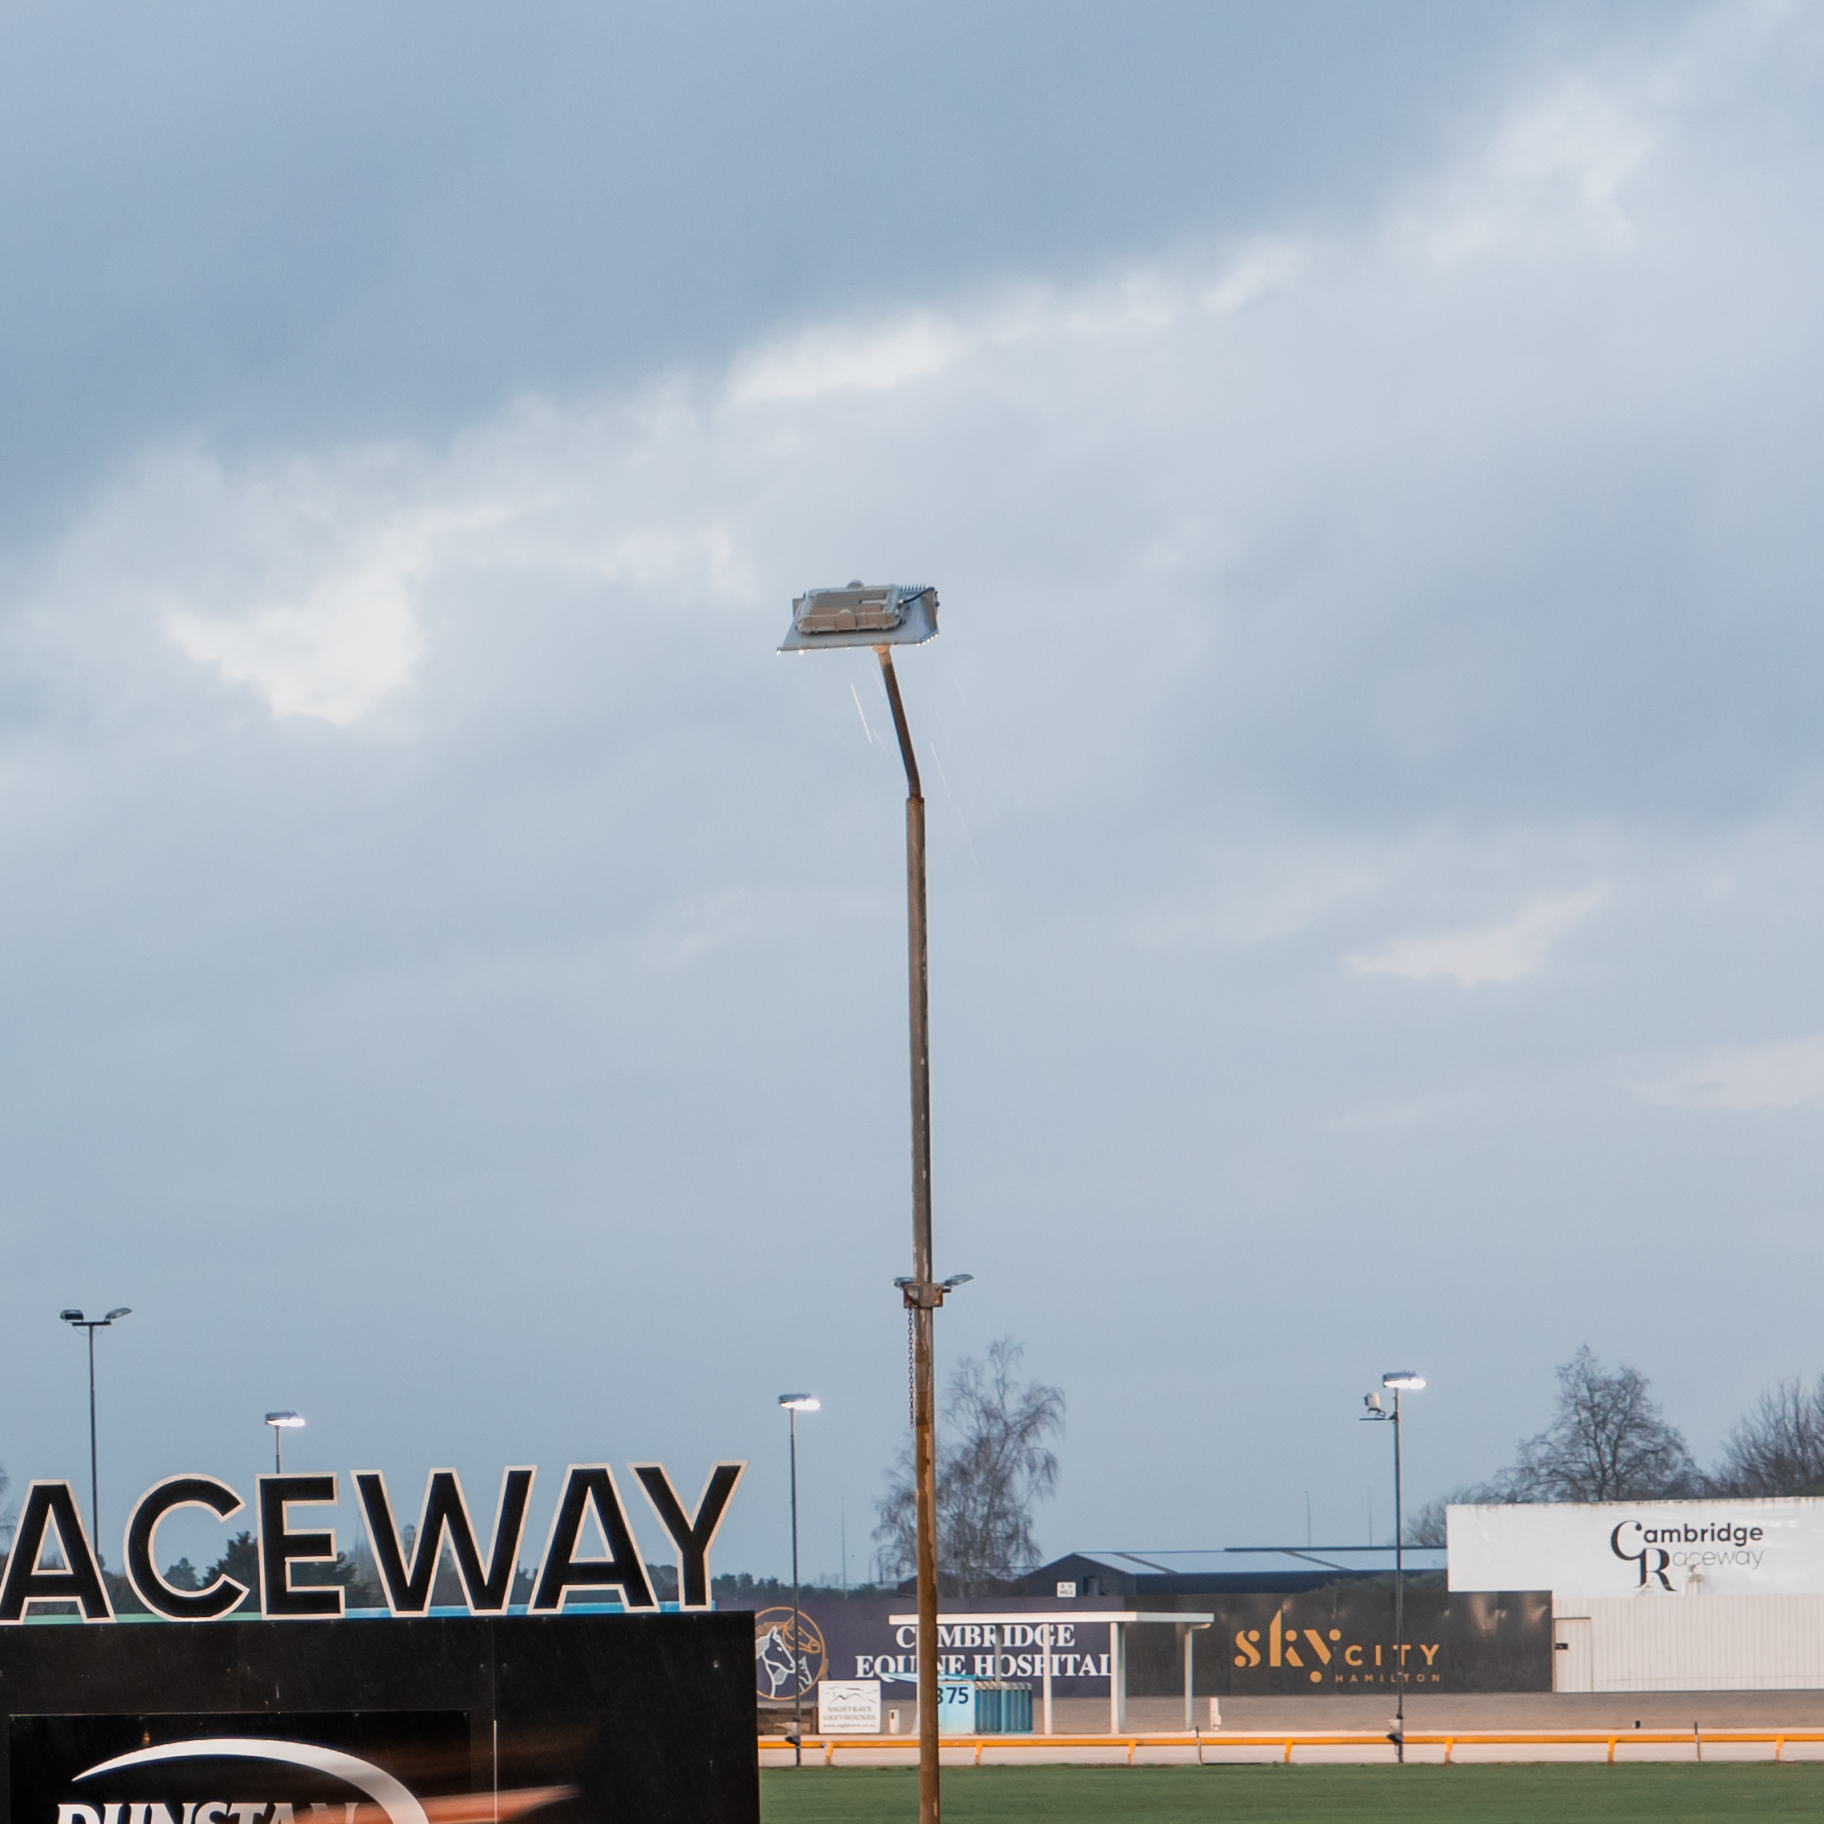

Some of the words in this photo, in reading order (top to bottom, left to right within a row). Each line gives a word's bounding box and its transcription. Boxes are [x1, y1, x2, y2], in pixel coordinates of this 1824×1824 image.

[1610, 1519, 1764, 1561] Cambridge
[1634, 1547, 1764, 1592] Raceway
[895, 1624, 1075, 1648] CMBRIDGE
[855, 1655, 966, 1682] EQUNE
[1335, 1674, 1440, 1684] HAMILTON
